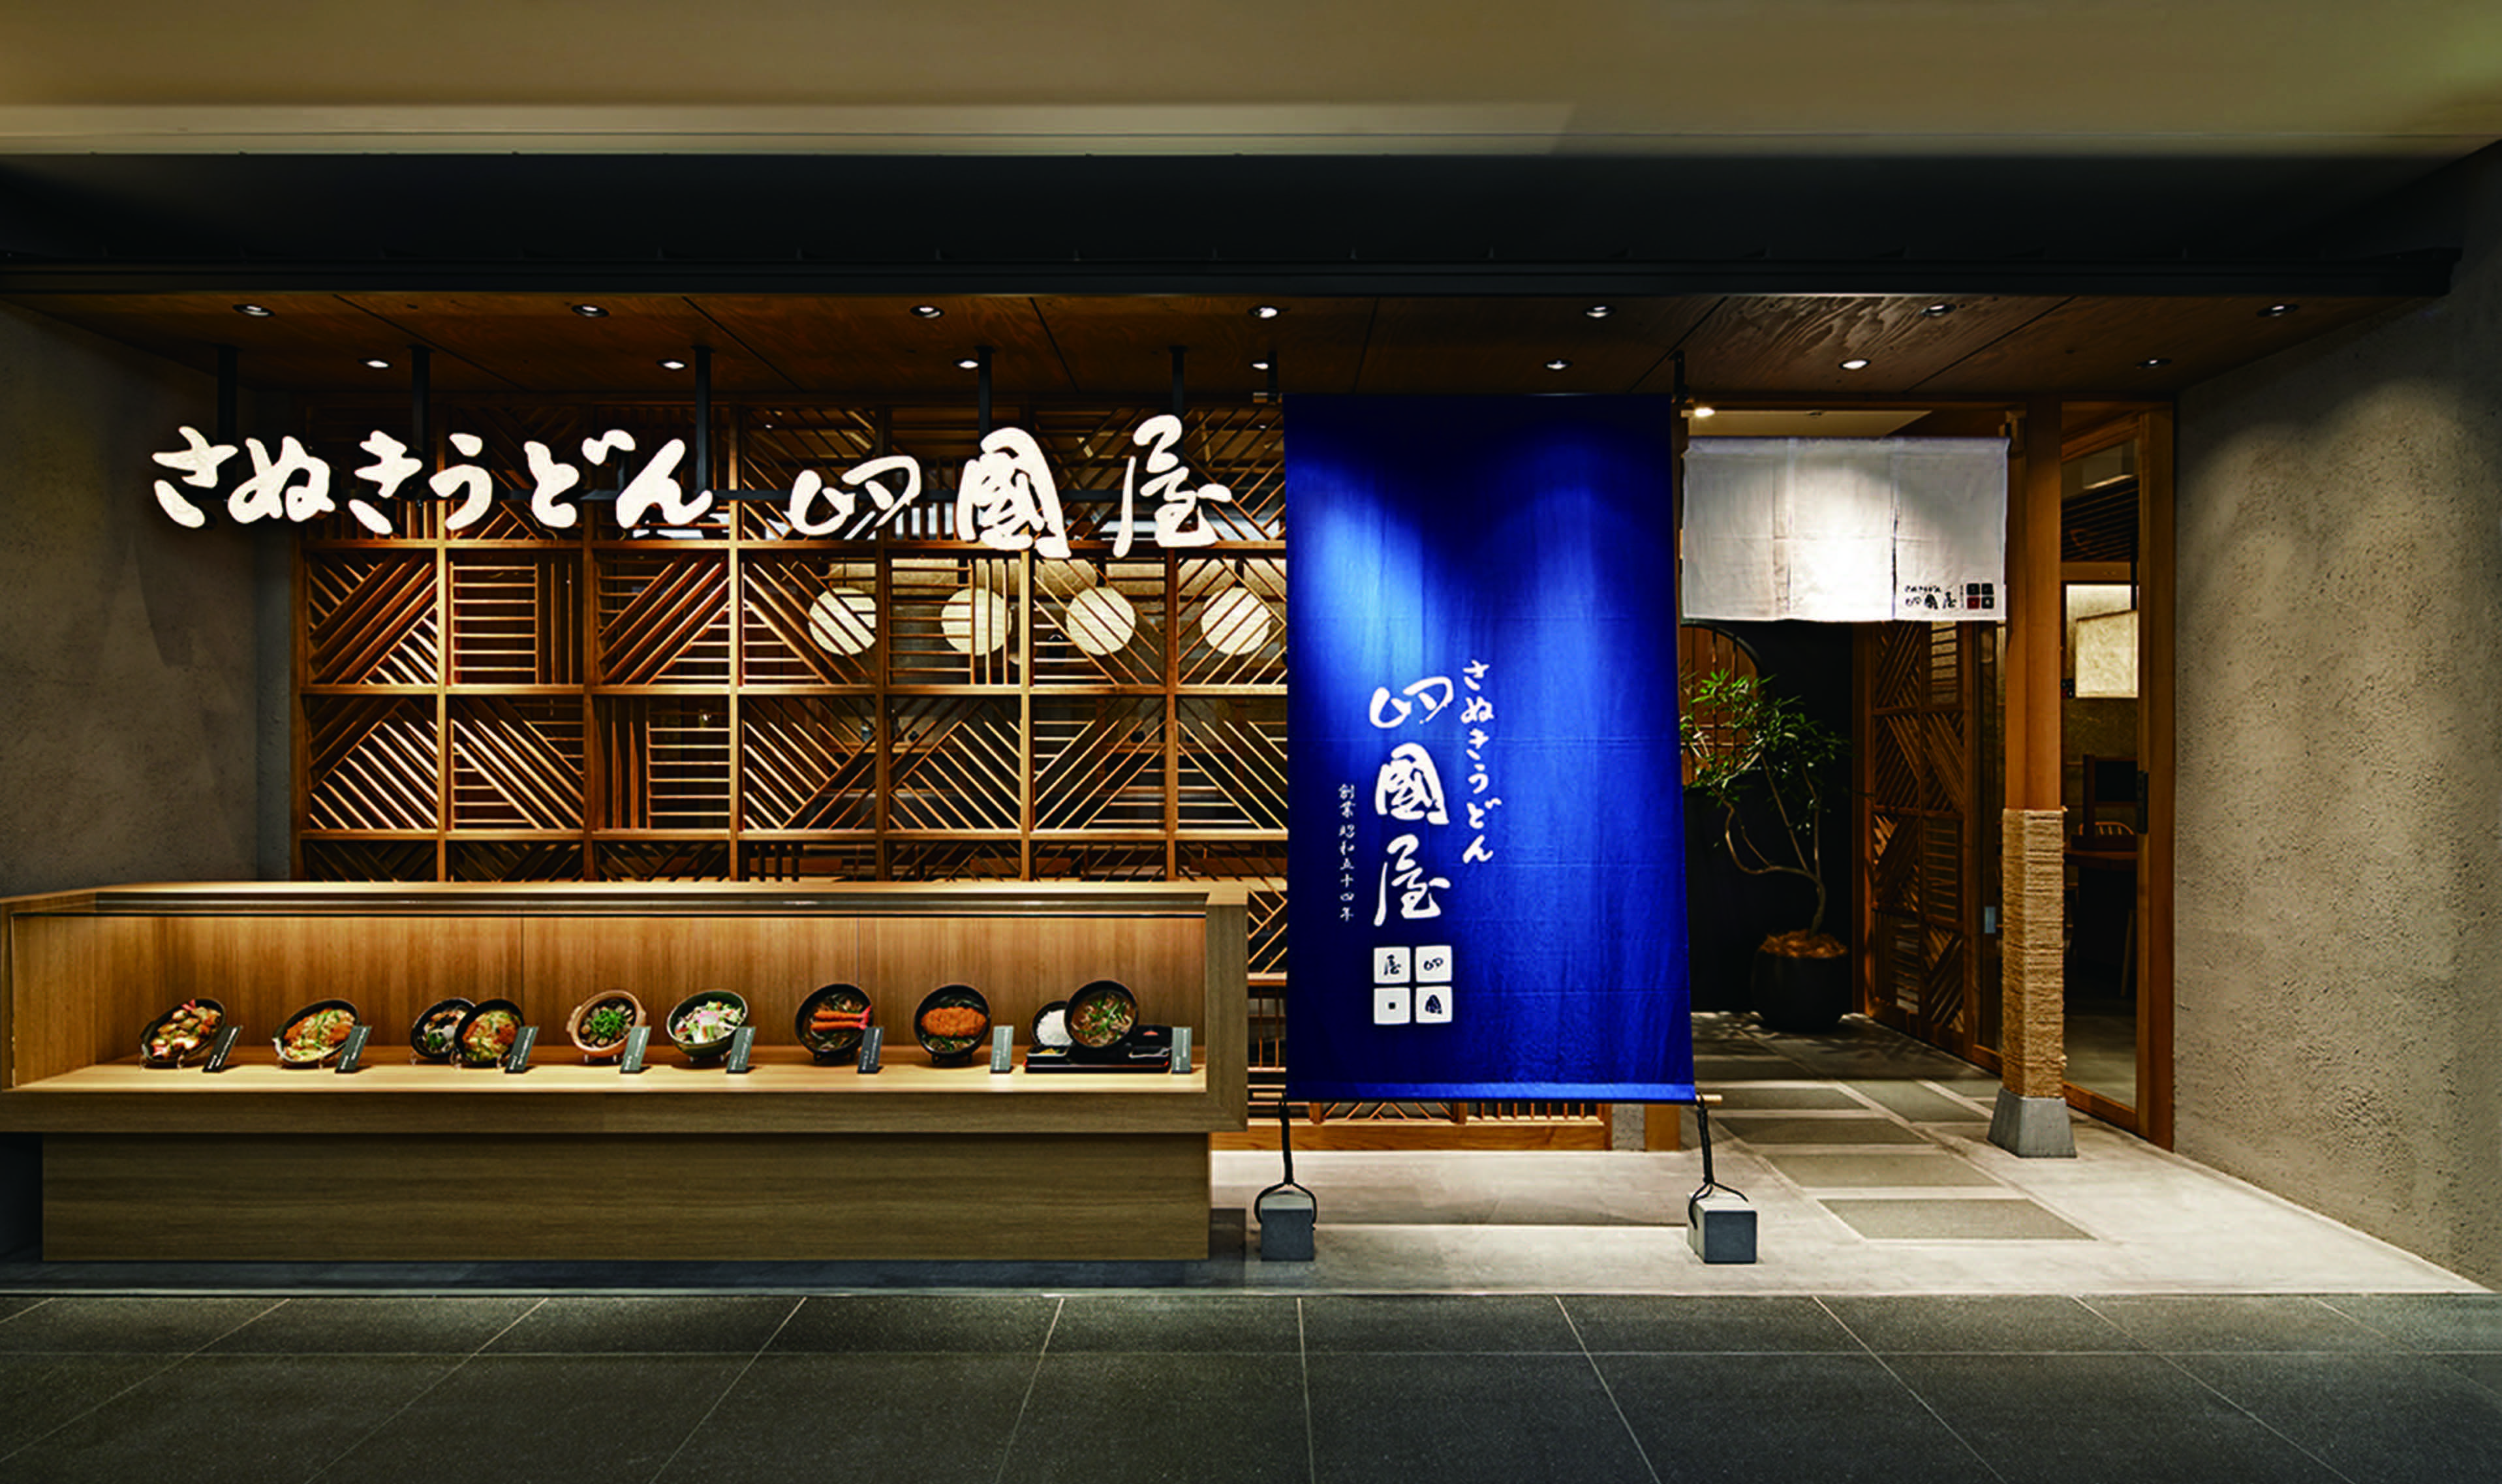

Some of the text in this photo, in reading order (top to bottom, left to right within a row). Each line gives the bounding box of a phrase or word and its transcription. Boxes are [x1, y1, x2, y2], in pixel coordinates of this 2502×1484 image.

[152, 414, 1232, 559] さぬきうどん 四國屋
[1369, 675, 1454, 927] 四國屋
[1460, 660, 1502, 863] さぬきうどん
